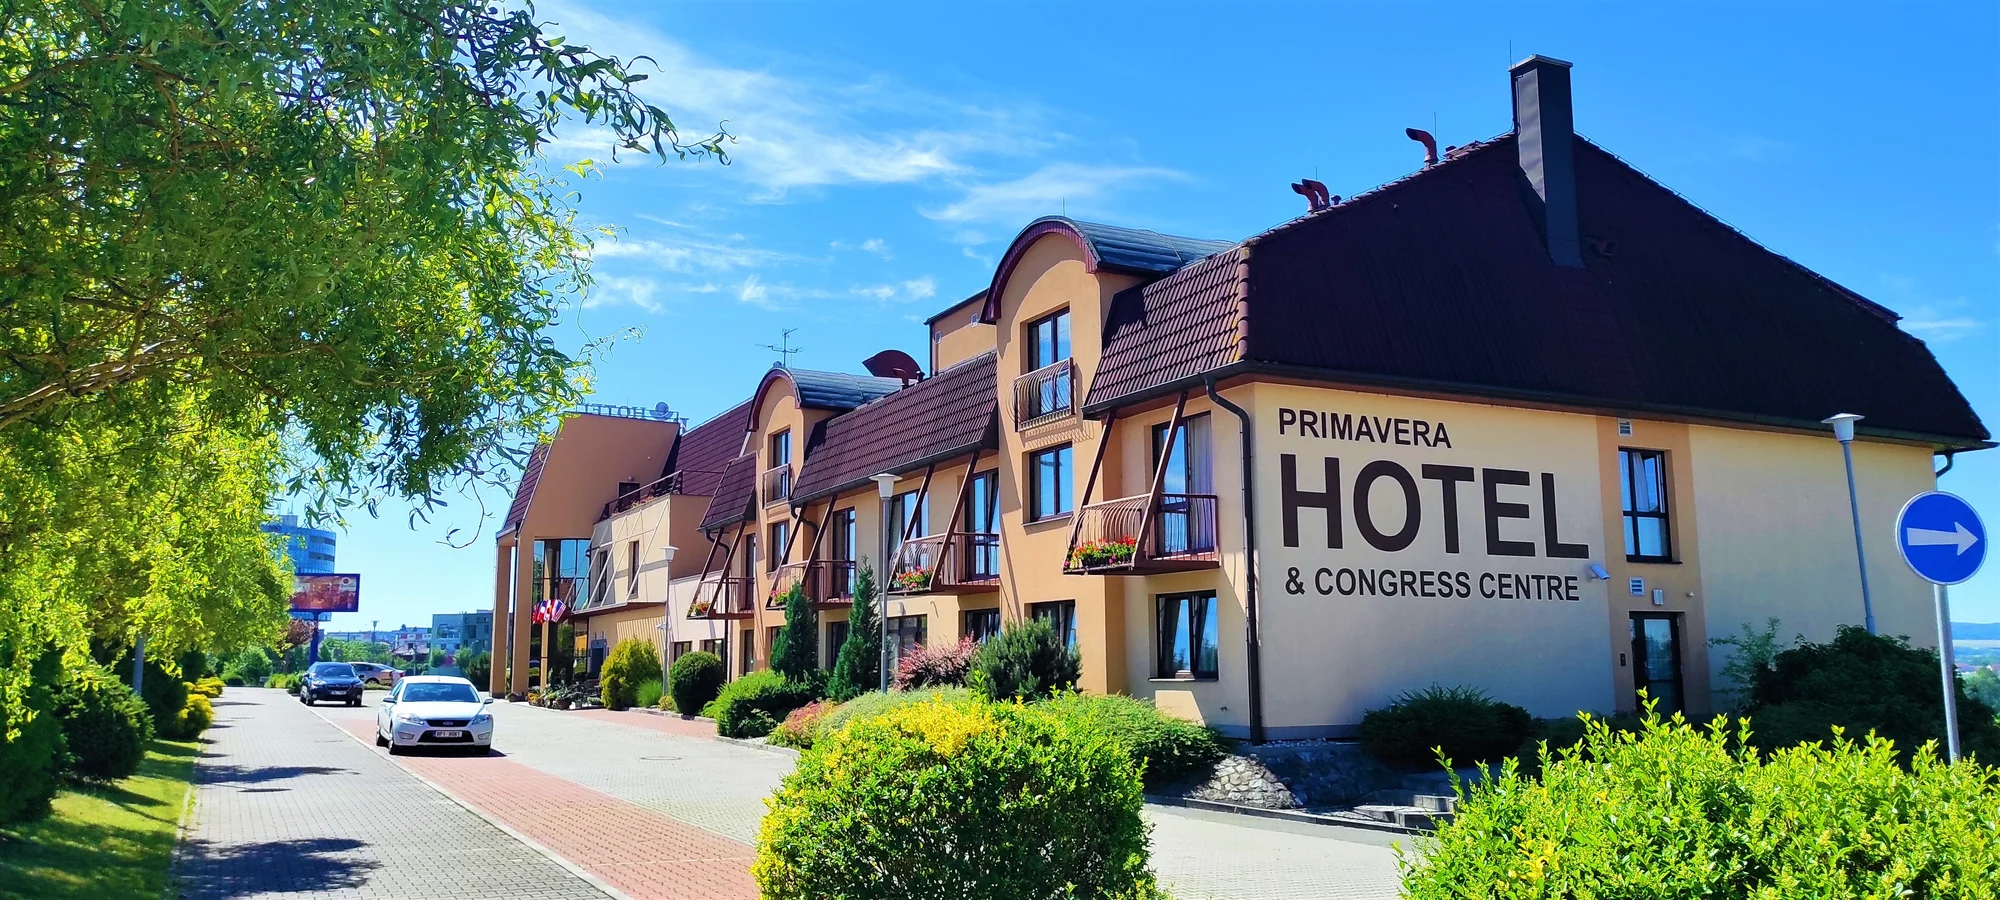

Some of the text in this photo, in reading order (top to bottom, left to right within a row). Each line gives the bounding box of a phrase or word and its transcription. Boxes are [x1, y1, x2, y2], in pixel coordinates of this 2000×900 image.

[1278, 407, 1452, 449] PRIMAVERA
[1280, 453, 1590, 559] HOTEL
[1285, 566, 1580, 602] & CONGRESS CENTRE
